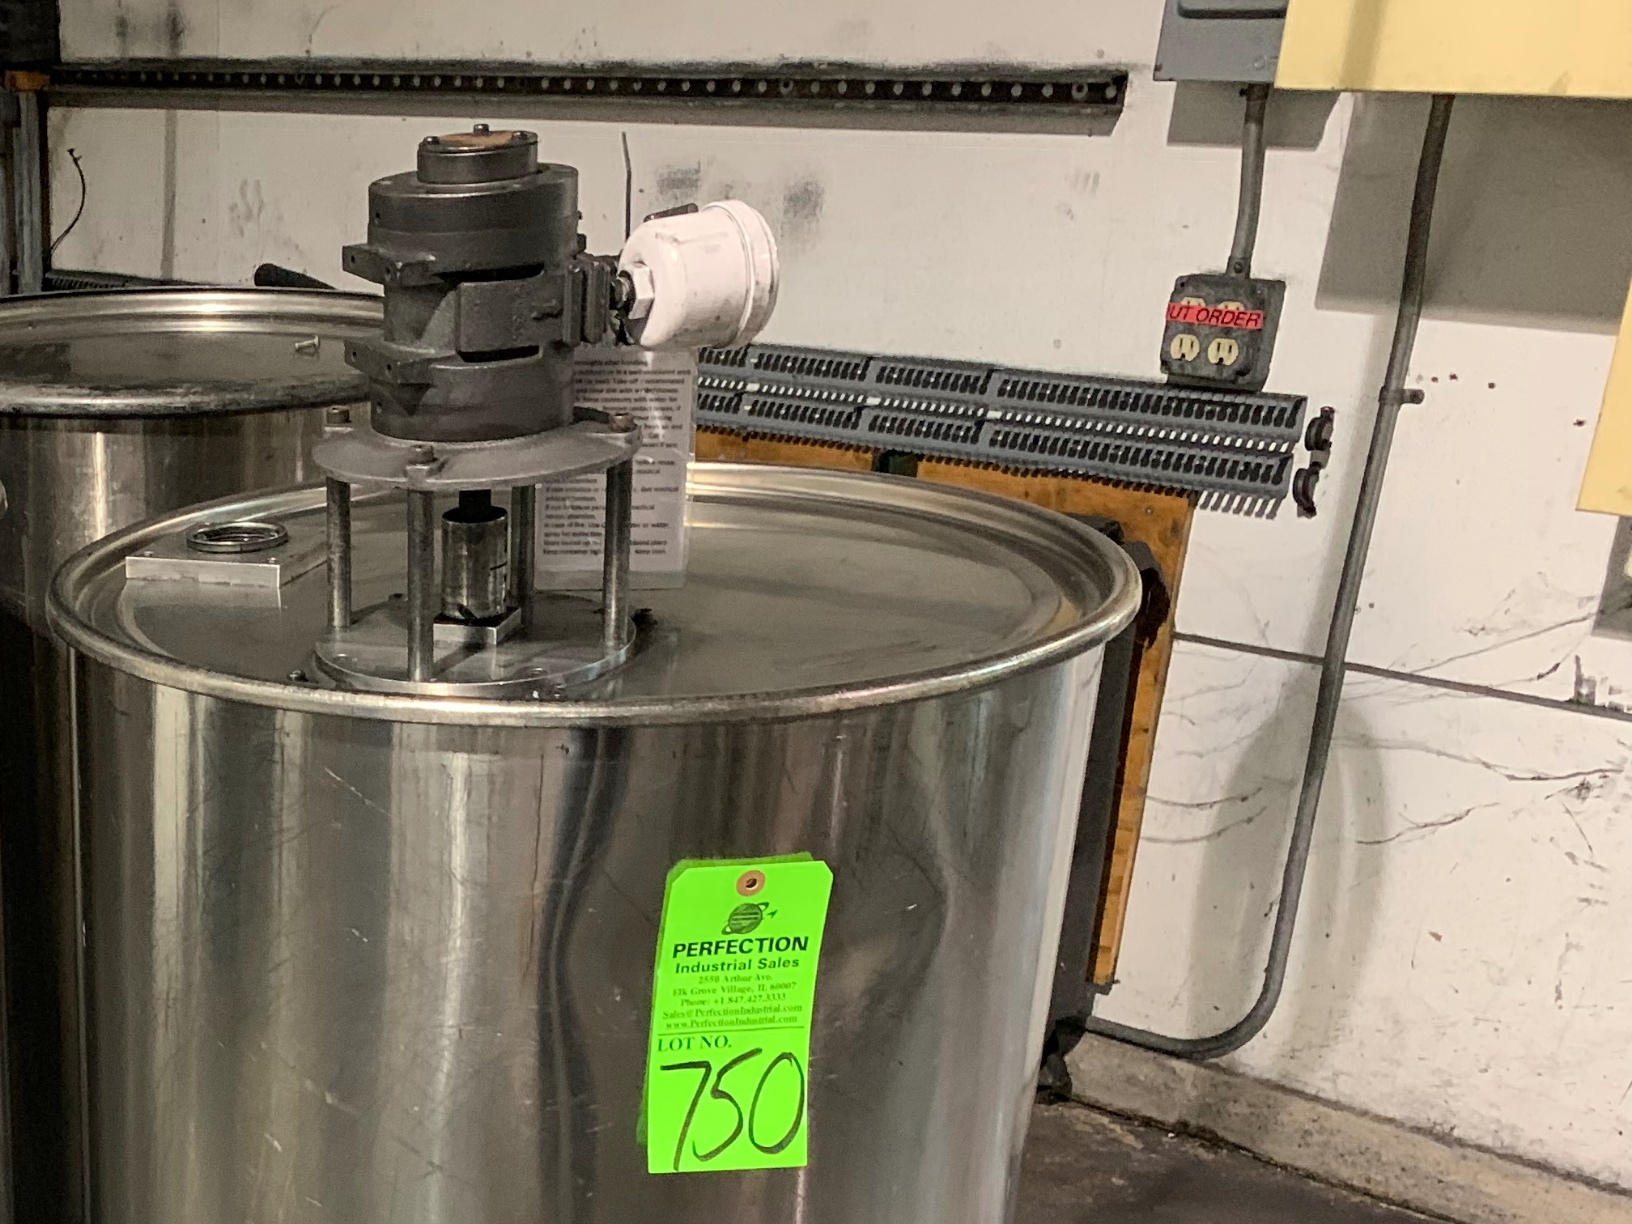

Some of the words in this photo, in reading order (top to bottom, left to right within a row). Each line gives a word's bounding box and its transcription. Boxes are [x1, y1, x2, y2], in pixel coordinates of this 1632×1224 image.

[1167, 304, 1194, 320] UT
[1196, 307, 1261, 327] ORDER
[672, 936, 809, 958] PERFECTION
[675, 958, 752, 974] Industrial
[758, 957, 800, 970] Sales
[723, 973, 751, 983] Arthur
[672, 987, 688, 997] Elk
[690, 986, 717, 996] Grove
[666, 1014, 798, 1030] www.PerfectionIndustrial.com
[658, 1037, 695, 1051] LOT
[700, 1035, 732, 1049] NO.
[660, 1048, 805, 1172] 750
